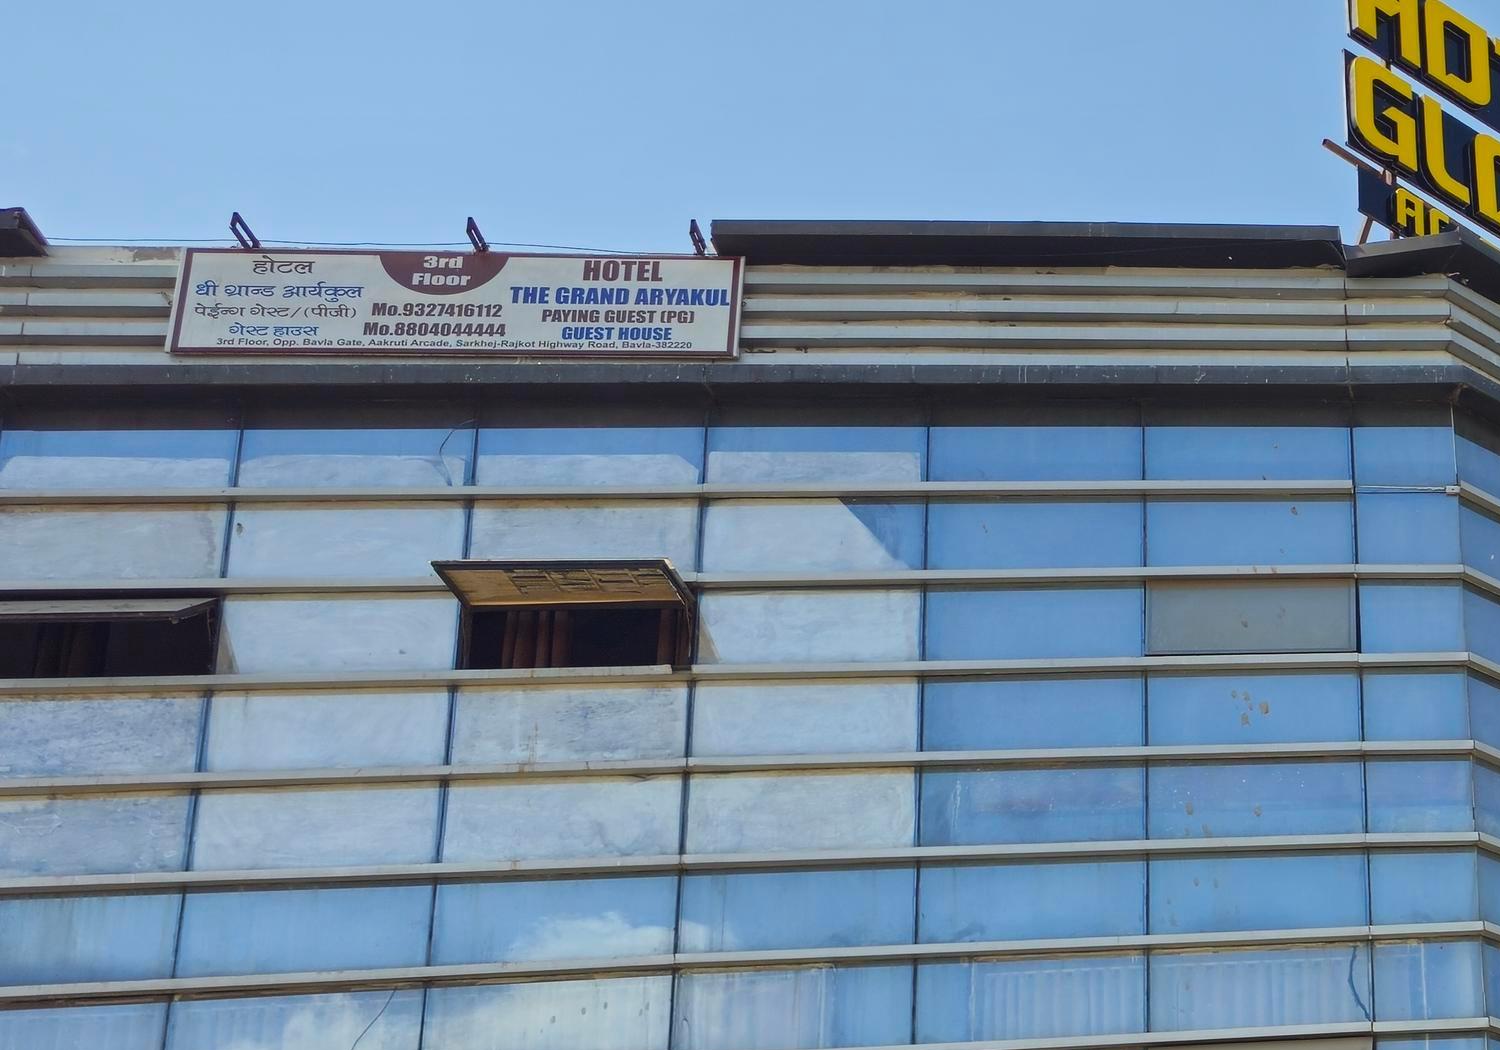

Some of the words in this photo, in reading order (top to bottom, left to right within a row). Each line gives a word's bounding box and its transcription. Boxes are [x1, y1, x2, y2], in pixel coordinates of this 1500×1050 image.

[252, 254, 316, 275] होटल
[423, 255, 464, 269] 3rd
[582, 260, 663, 282] HOTEL
[411, 272, 472, 286] Floor
[282, 281, 365, 303] आर्यकुल
[510, 286, 550, 304] THE
[555, 287, 630, 306] GRAND
[634, 288, 730, 307] ARYAKUL
[371, 302, 502, 318] Mo.9327416112
[541, 309, 600, 323] PAYING
[604, 310, 656, 323] GUEST
[273, 325, 319, 338] हाउस
[363, 322, 506, 338] Mo.8804044444
[561, 326, 614, 340] GUEST
[618, 327, 672, 341] HOUSE
[216, 337, 235, 346] 3rd
[238, 338, 269, 347] Floor,
[272, 338, 299, 348] Opp.
[336, 338, 365, 348] Gate,
[368, 339, 408, 348] Aakruti
[411, 339, 453, 348] Arcade,
[456, 339, 536, 350] Sarkhej-Rajkot
[538, 340, 584, 350] Highway
[588, 340, 618, 349] Road,
